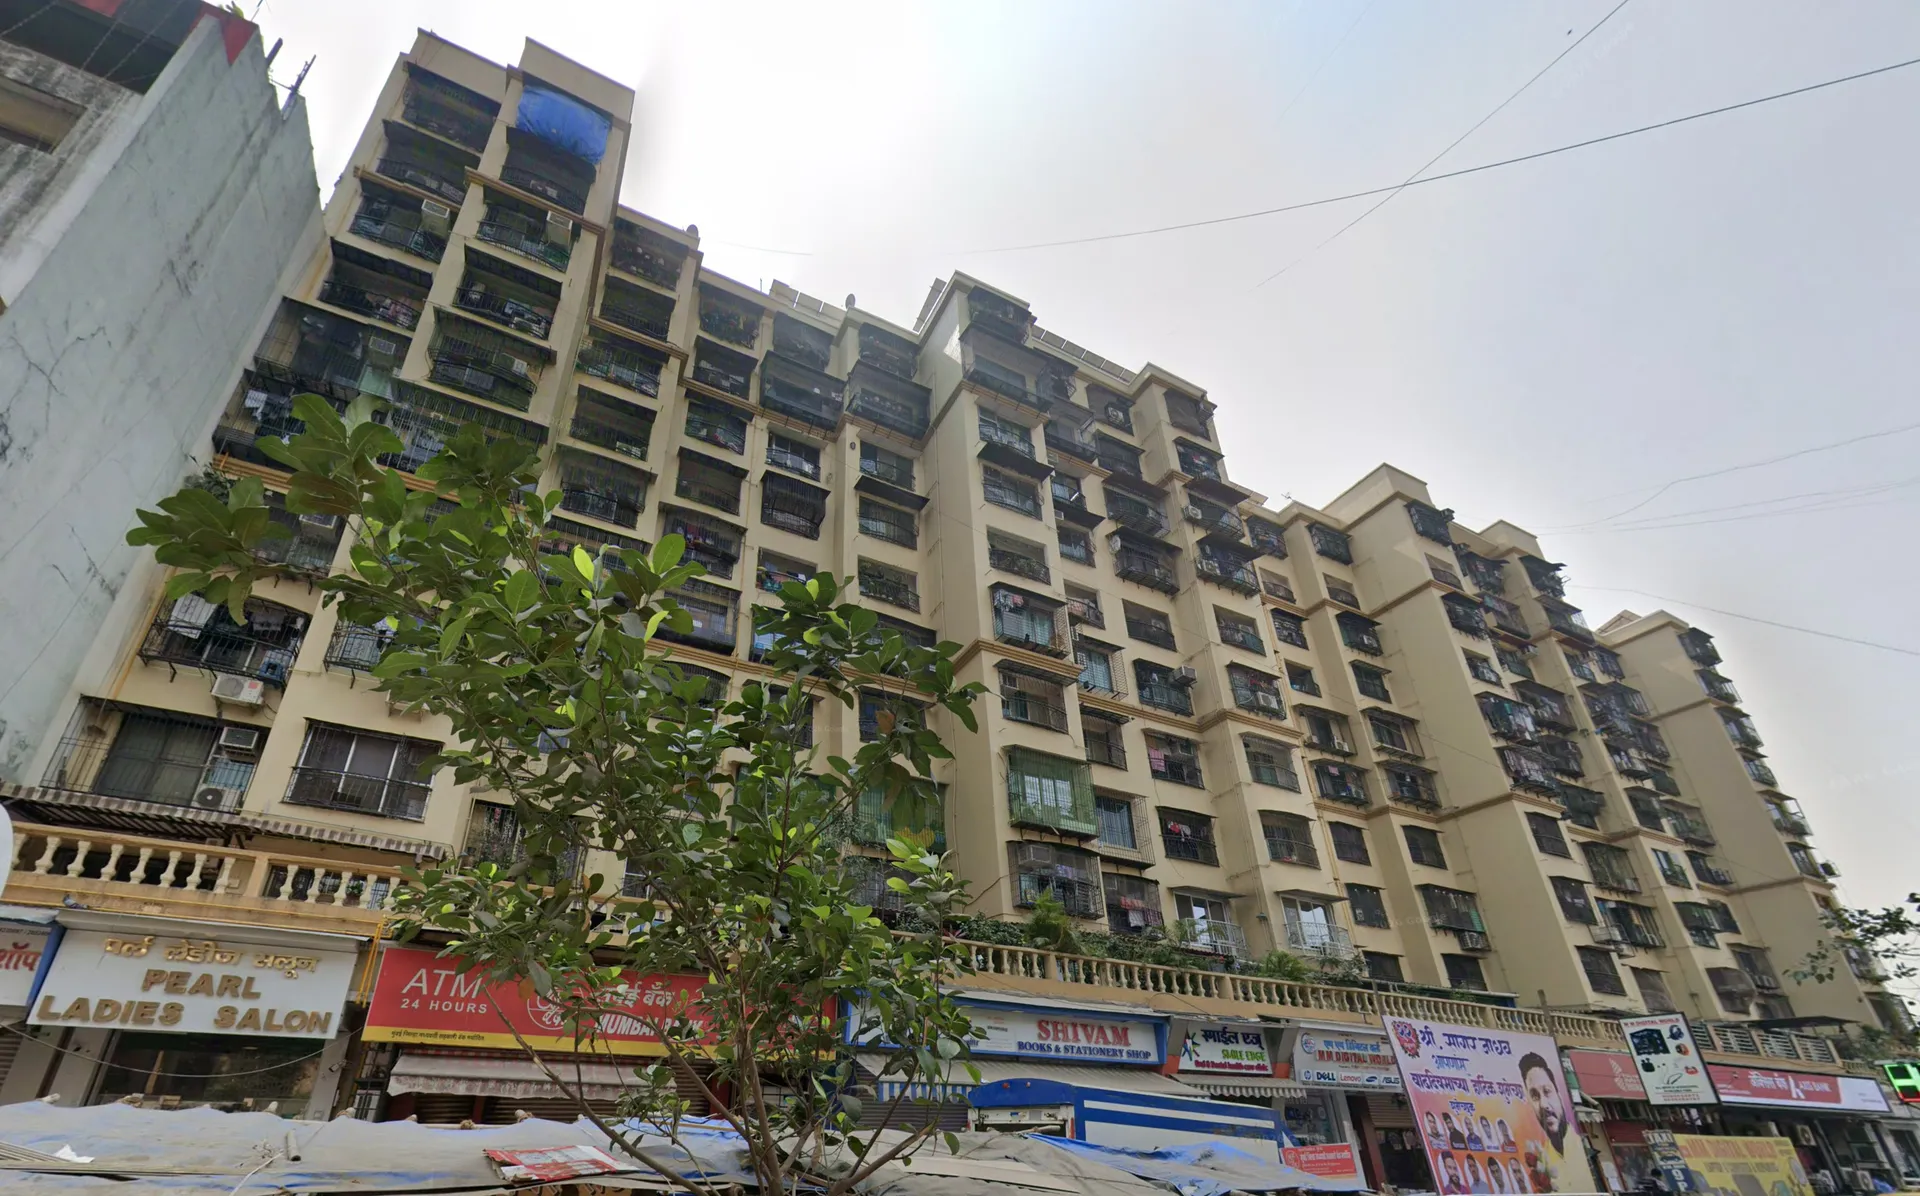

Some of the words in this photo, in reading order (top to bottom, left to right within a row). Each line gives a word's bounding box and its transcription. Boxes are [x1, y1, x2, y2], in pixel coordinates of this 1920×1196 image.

[140, 968, 262, 999] PEARL
[401, 968, 483, 999] ATM
[36, 995, 185, 1026] LADIES
[213, 1005, 333, 1034] SALON
[401, 998, 420, 1009] 24
[429, 1000, 488, 1014] HOURS
[1036, 1019, 1131, 1047] SHIVAM
[1017, 1040, 1052, 1053] BOOKS
[1054, 1044, 1062, 1054] &
[1063, 1044, 1125, 1058] STATIONERY
[1126, 1049, 1151, 1059] SHOP
[1335, 1051, 1367, 1063] DIGITAL
[1316, 1071, 1336, 1082] DELL
[1340, 1074, 1362, 1082] Lenovo
[1672, 1169, 1685, 1181] 9
